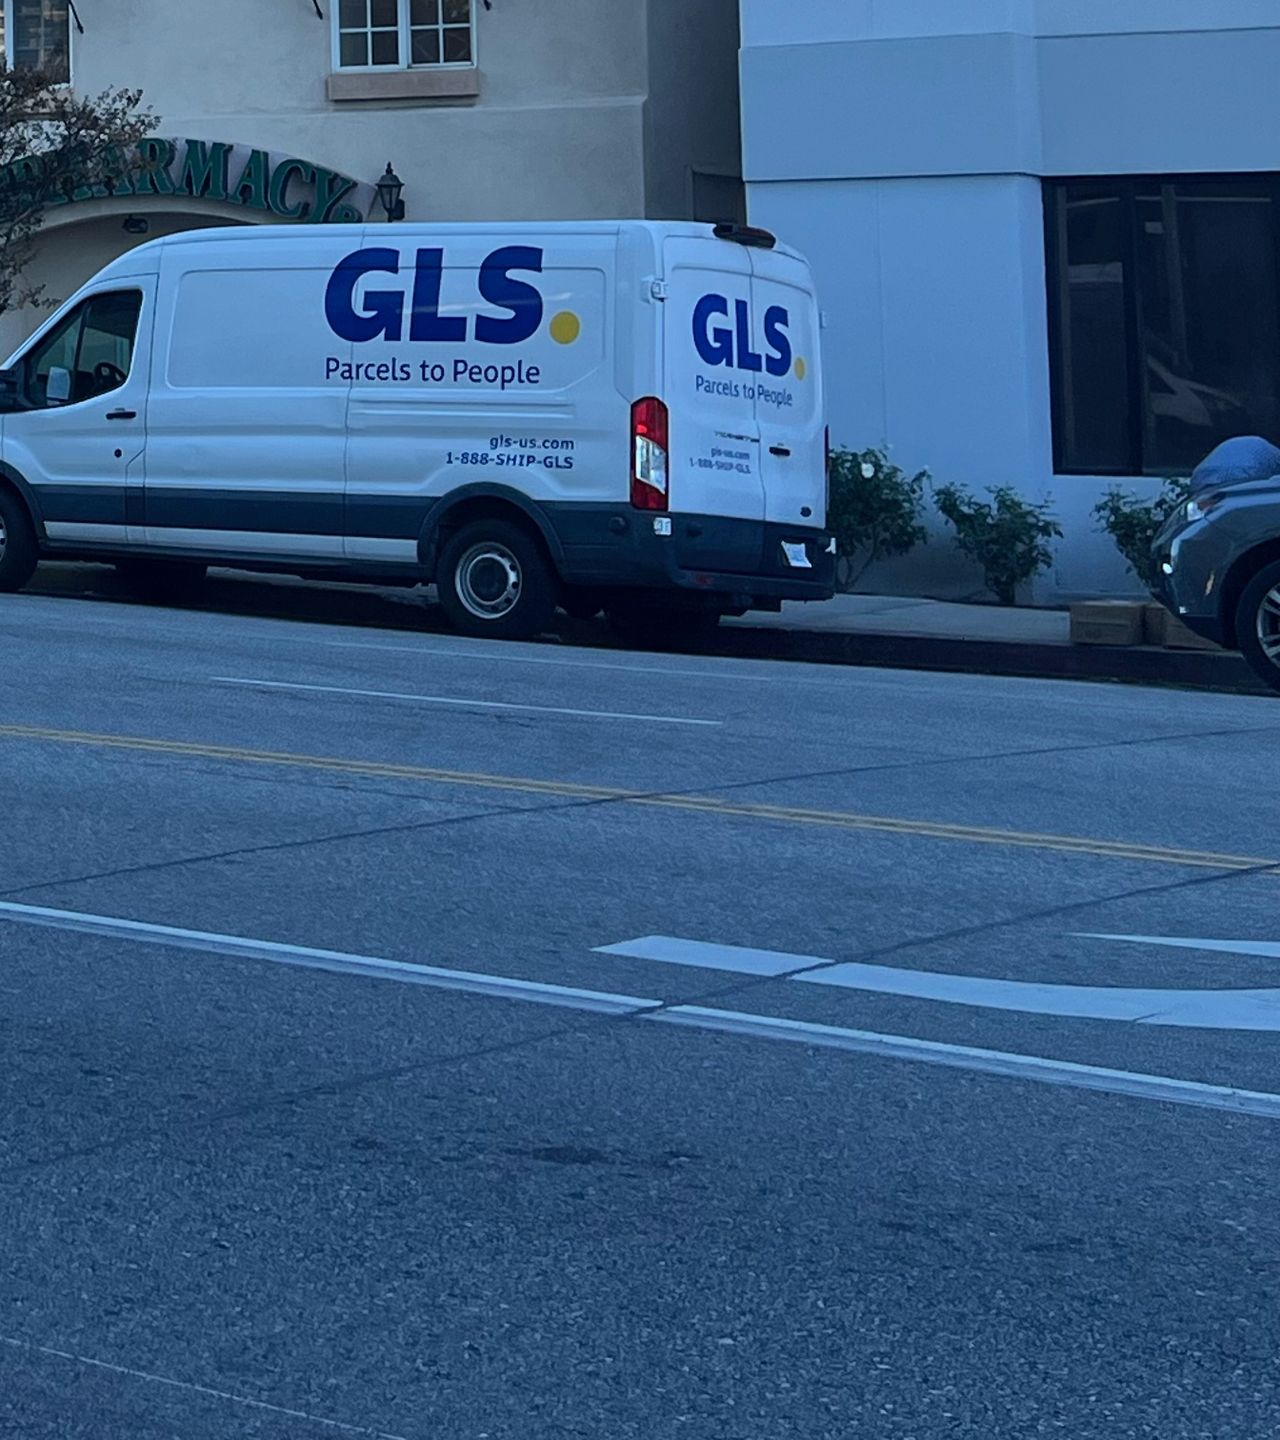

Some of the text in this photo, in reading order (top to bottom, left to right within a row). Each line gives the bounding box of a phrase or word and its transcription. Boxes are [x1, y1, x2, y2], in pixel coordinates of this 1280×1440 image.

[10, 137, 358, 224] ARMACY
[325, 357, 540, 390] Parcels to People
[696, 375, 793, 408] Parcels to People
[490, 434, 574, 450] gls-us.com
[446, 451, 573, 469] 1-888-SHIP-GLS
